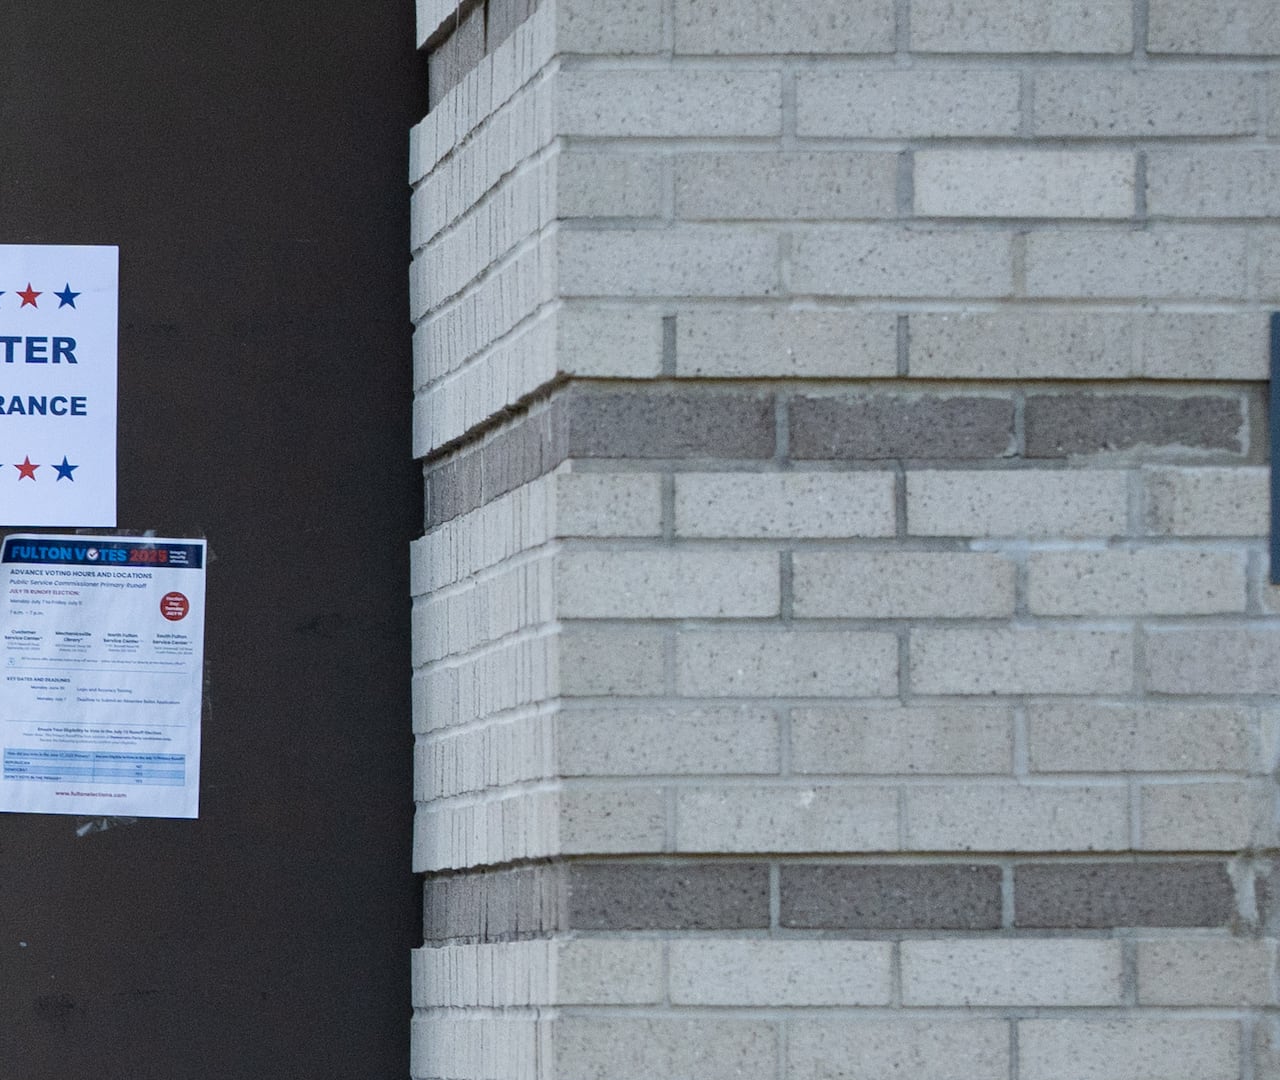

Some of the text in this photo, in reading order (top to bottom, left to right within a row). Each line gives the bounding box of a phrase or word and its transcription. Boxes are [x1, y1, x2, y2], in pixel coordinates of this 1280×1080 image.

[11, 546, 72, 560] FULTON
[129, 549, 167, 563] 2025
[45, 569, 72, 577] VOTING
[113, 571, 152, 579] LOCATIONS
[54, 580, 99, 588] Commissioner
